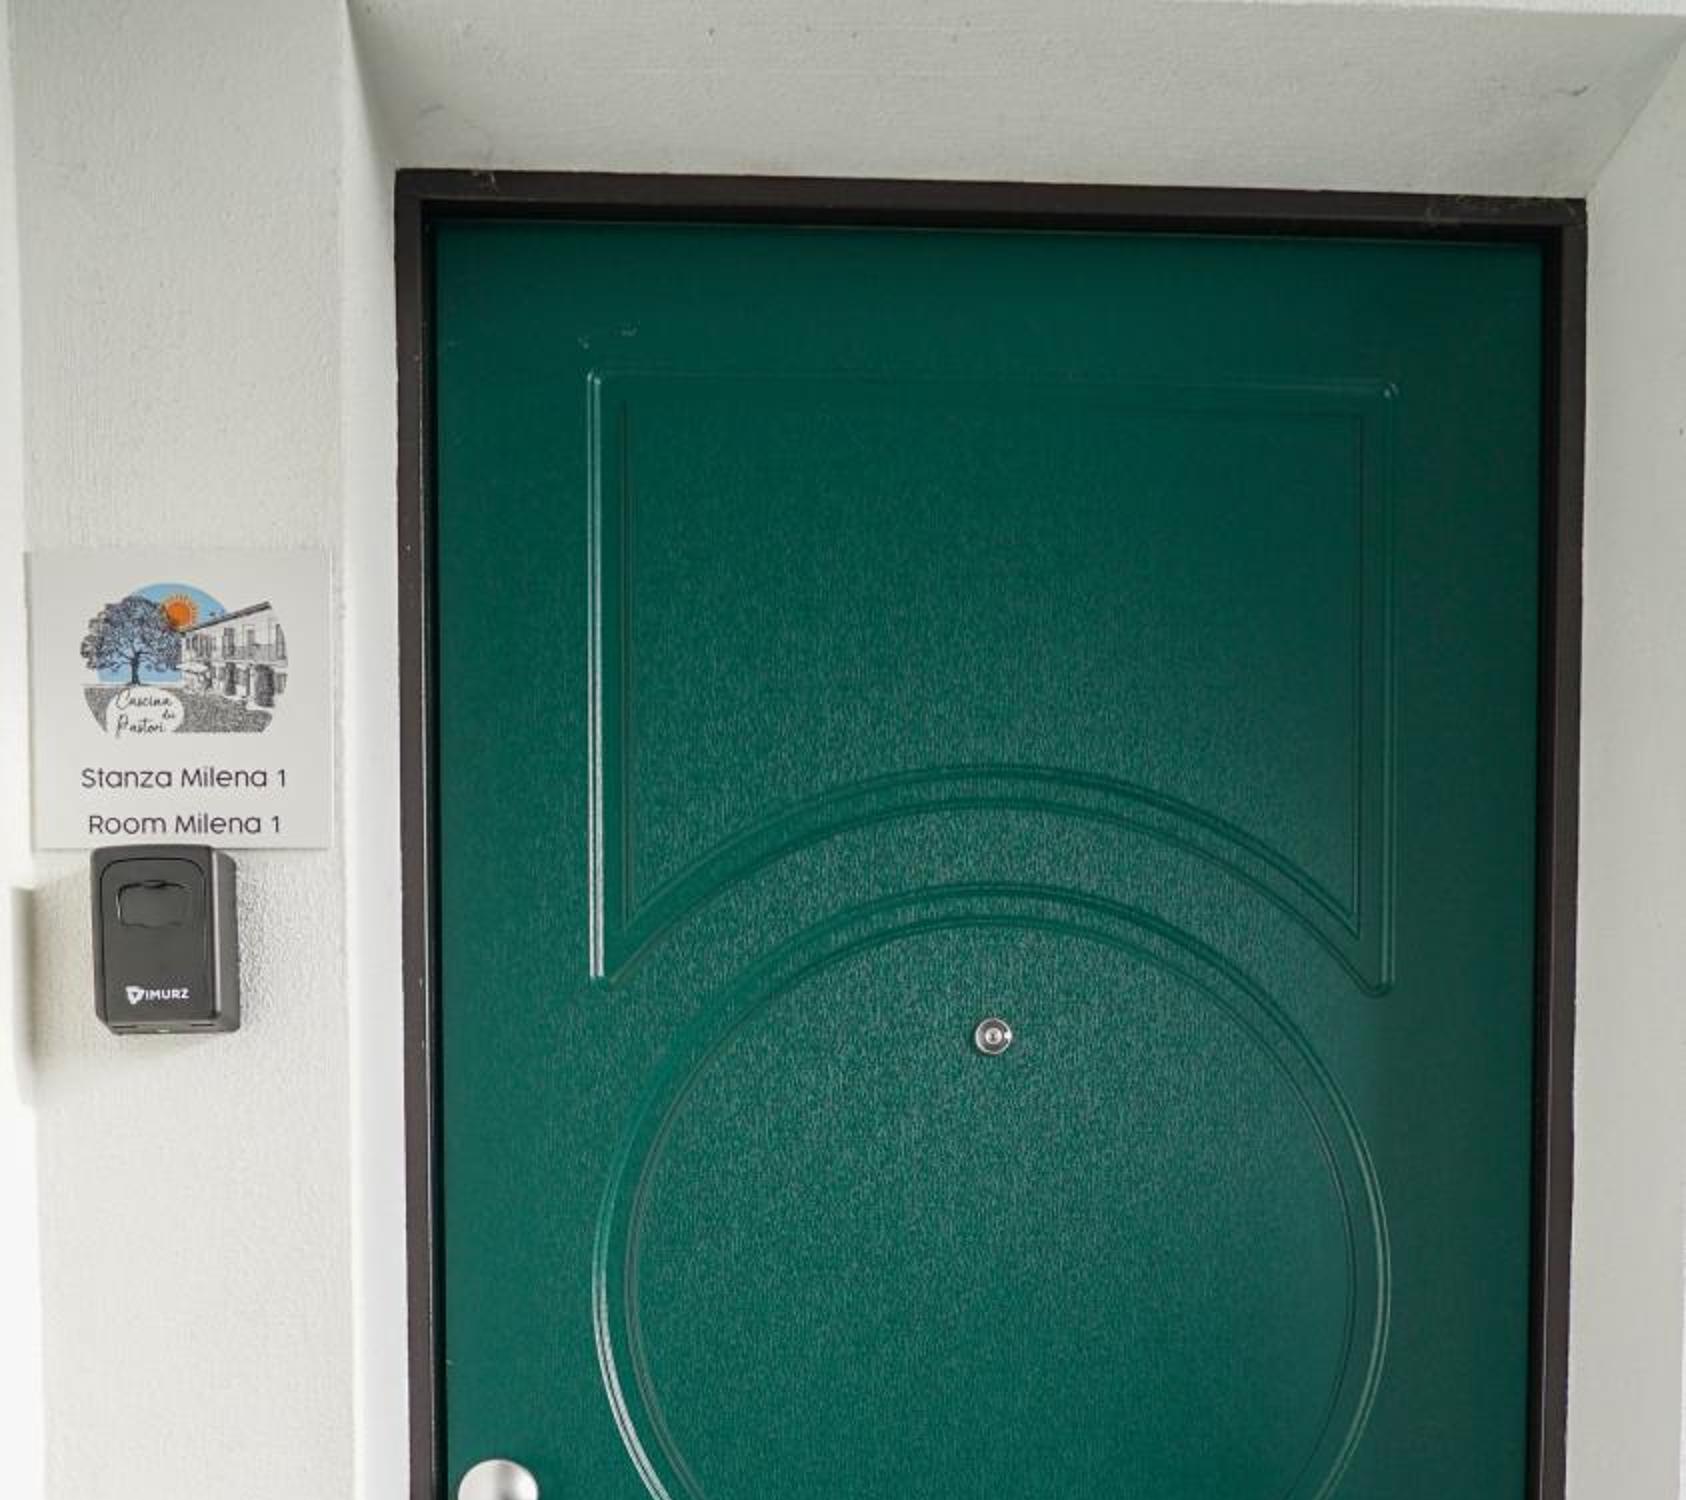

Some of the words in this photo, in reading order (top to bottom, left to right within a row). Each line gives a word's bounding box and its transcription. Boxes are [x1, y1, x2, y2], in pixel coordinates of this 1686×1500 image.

[114, 713, 164, 739] Pastori
[81, 767, 173, 789] Stanza
[180, 766, 267, 788] Milena
[277, 768, 287, 788] 1
[88, 814, 167, 835] Room
[174, 812, 261, 834] Milena
[271, 815, 280, 834] 1
